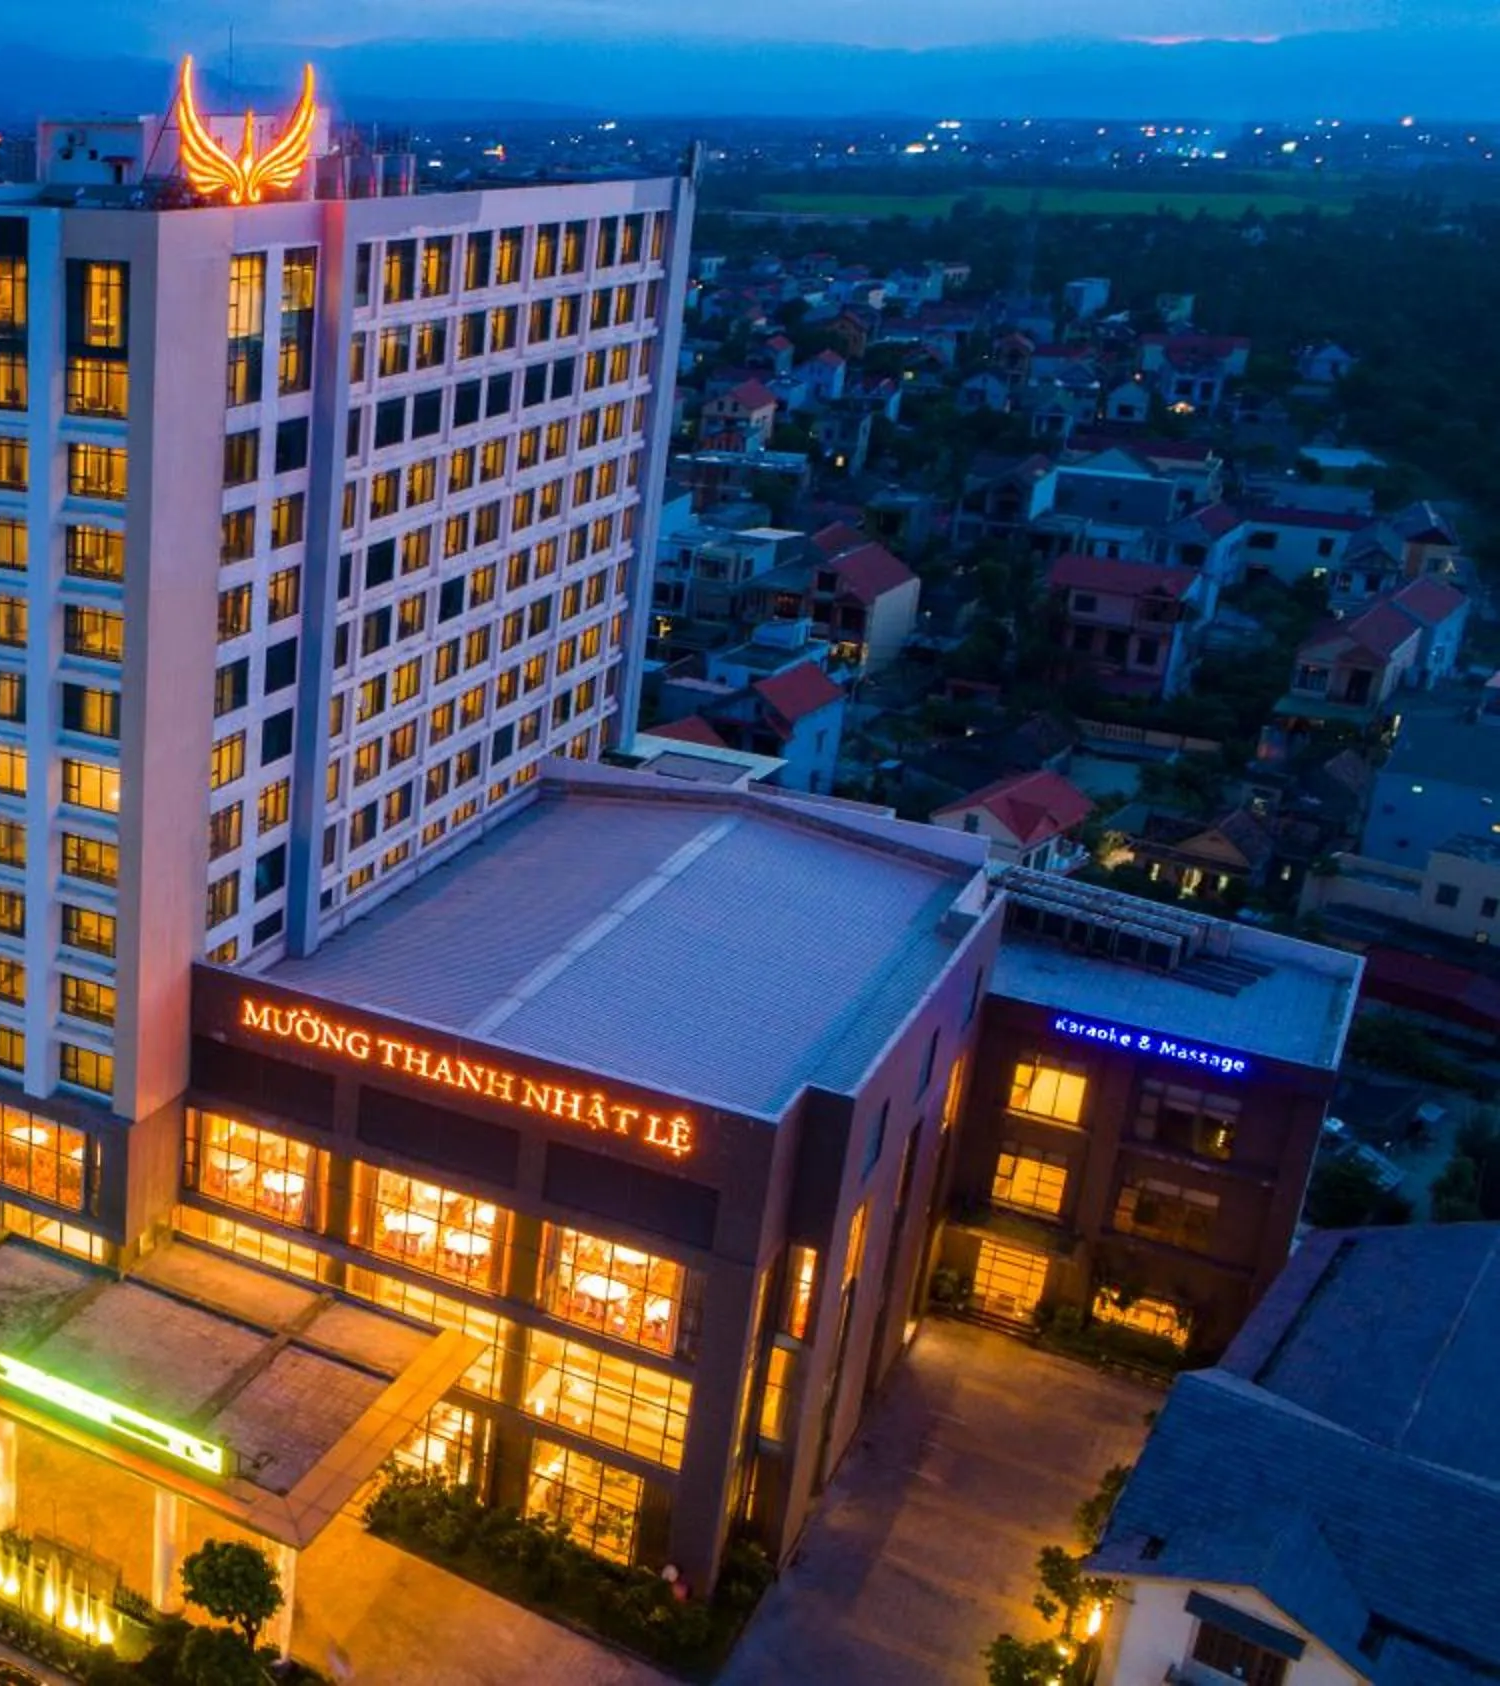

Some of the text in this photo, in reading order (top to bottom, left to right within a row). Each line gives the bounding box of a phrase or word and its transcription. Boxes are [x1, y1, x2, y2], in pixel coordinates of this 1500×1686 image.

[241, 998, 692, 1158] MƯỜNG THANH NHẬT LỆ
[1055, 1017, 1246, 1074] Karaoke & Massage
